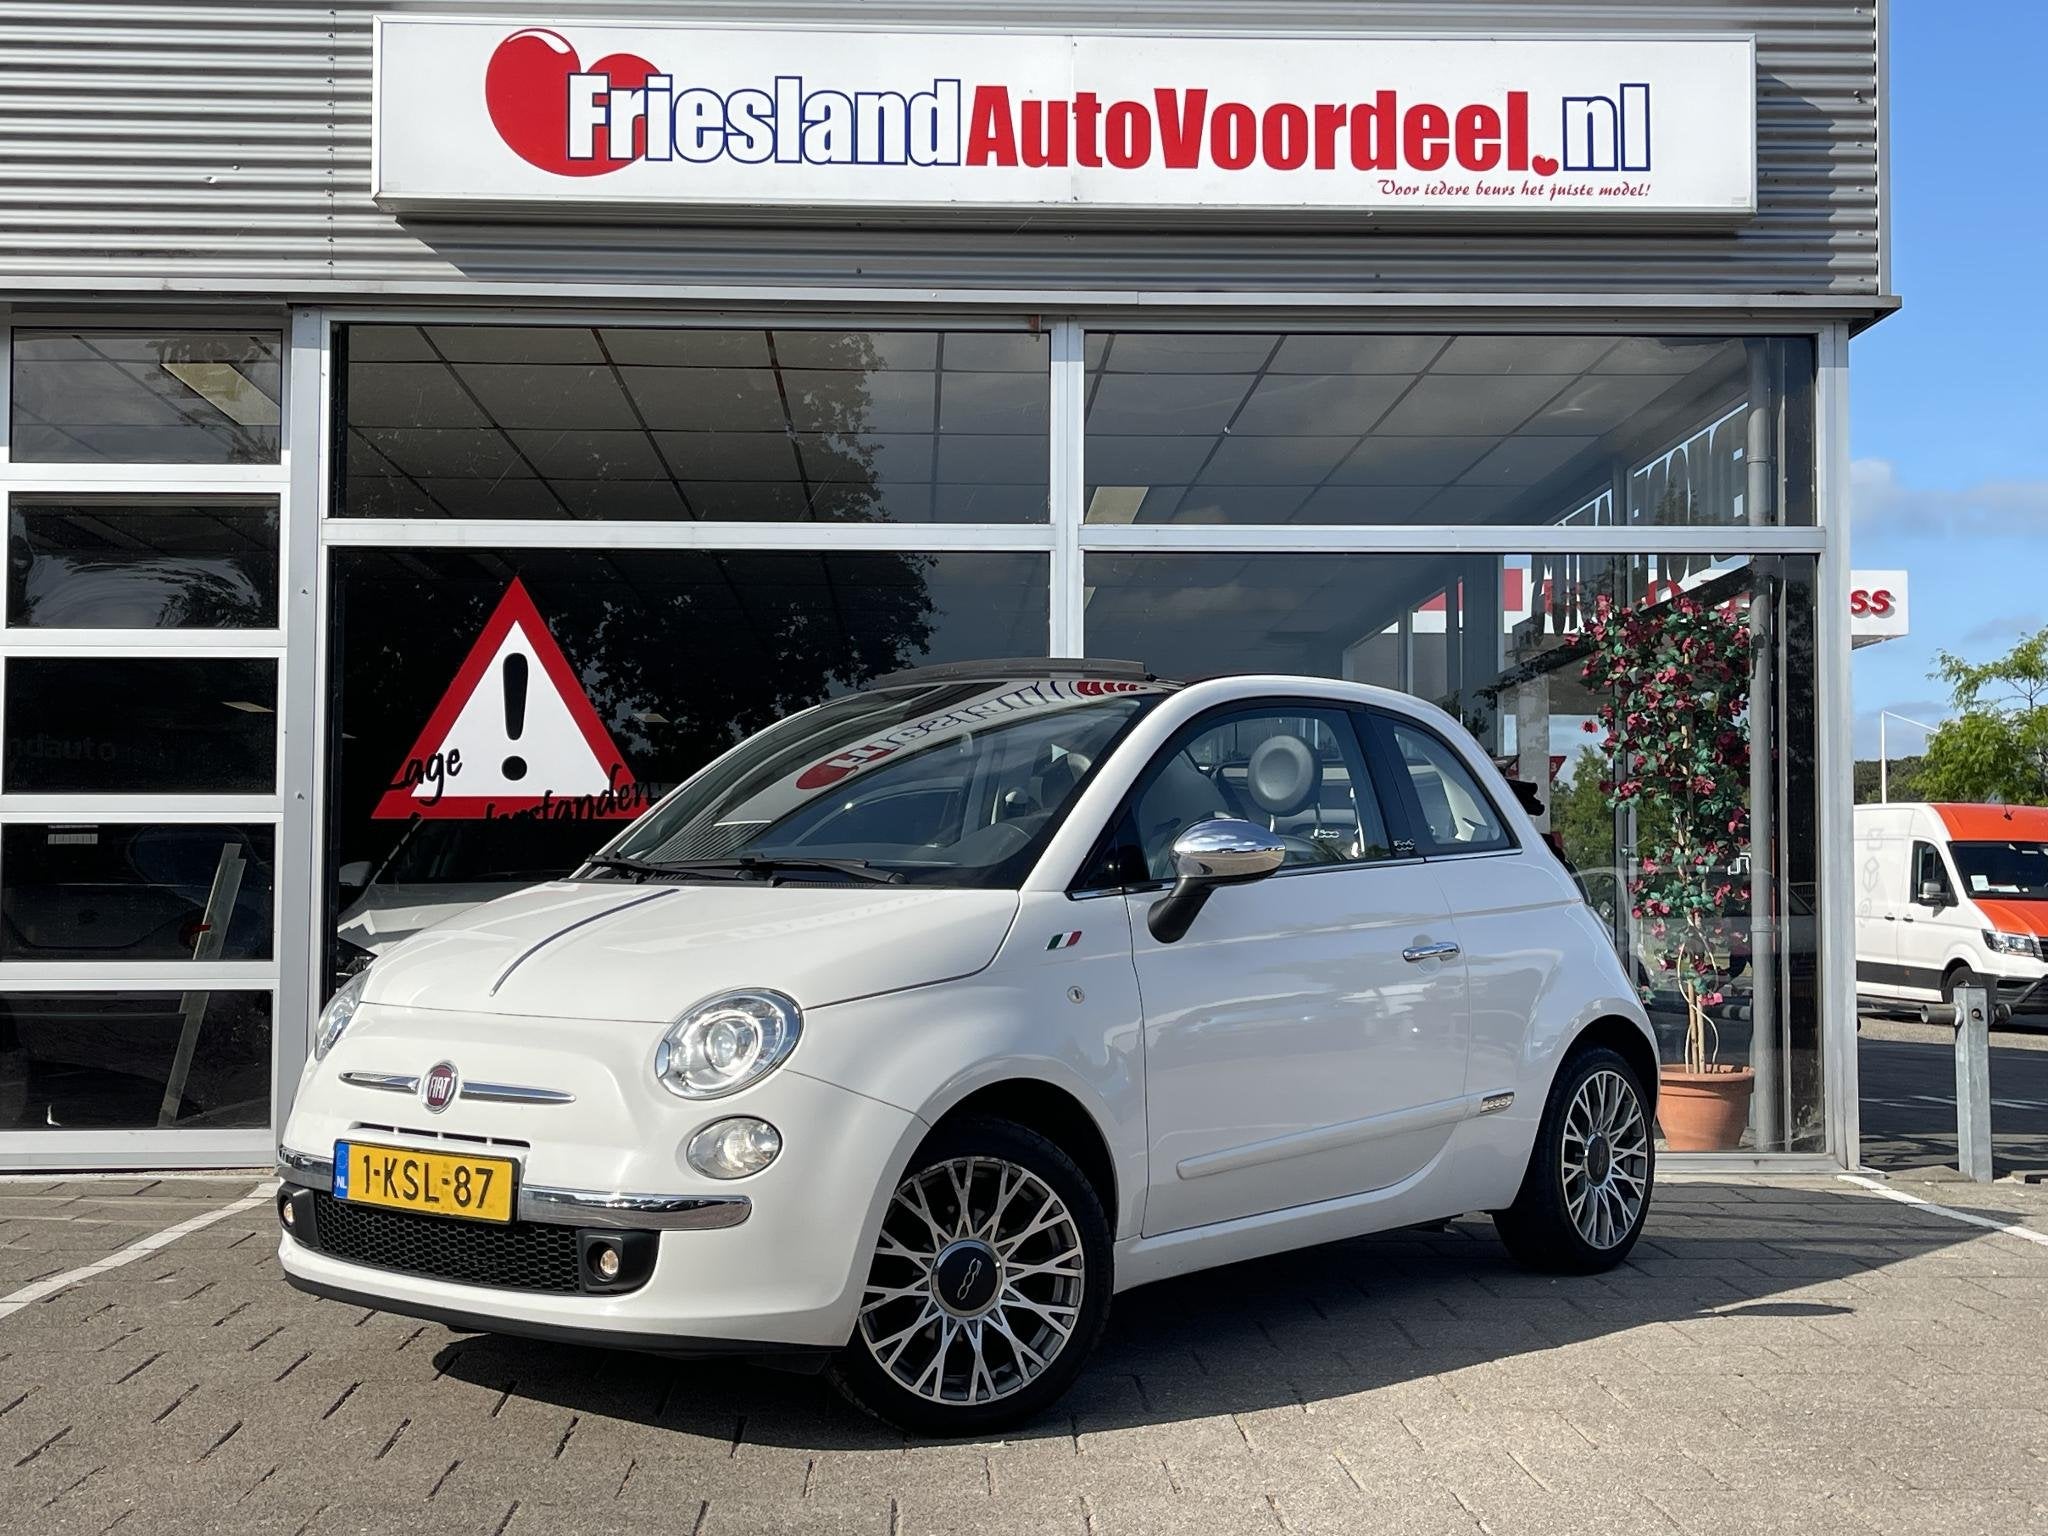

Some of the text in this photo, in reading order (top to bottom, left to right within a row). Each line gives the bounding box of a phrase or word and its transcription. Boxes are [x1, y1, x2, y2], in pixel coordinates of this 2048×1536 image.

[1377, 180, 1651, 201] Voor iedere beurs het juiste model!
[428, 1076, 451, 1099] FIAT
[336, 1175, 348, 1190] NL
[363, 1154, 494, 1208] 1-KSL-87
